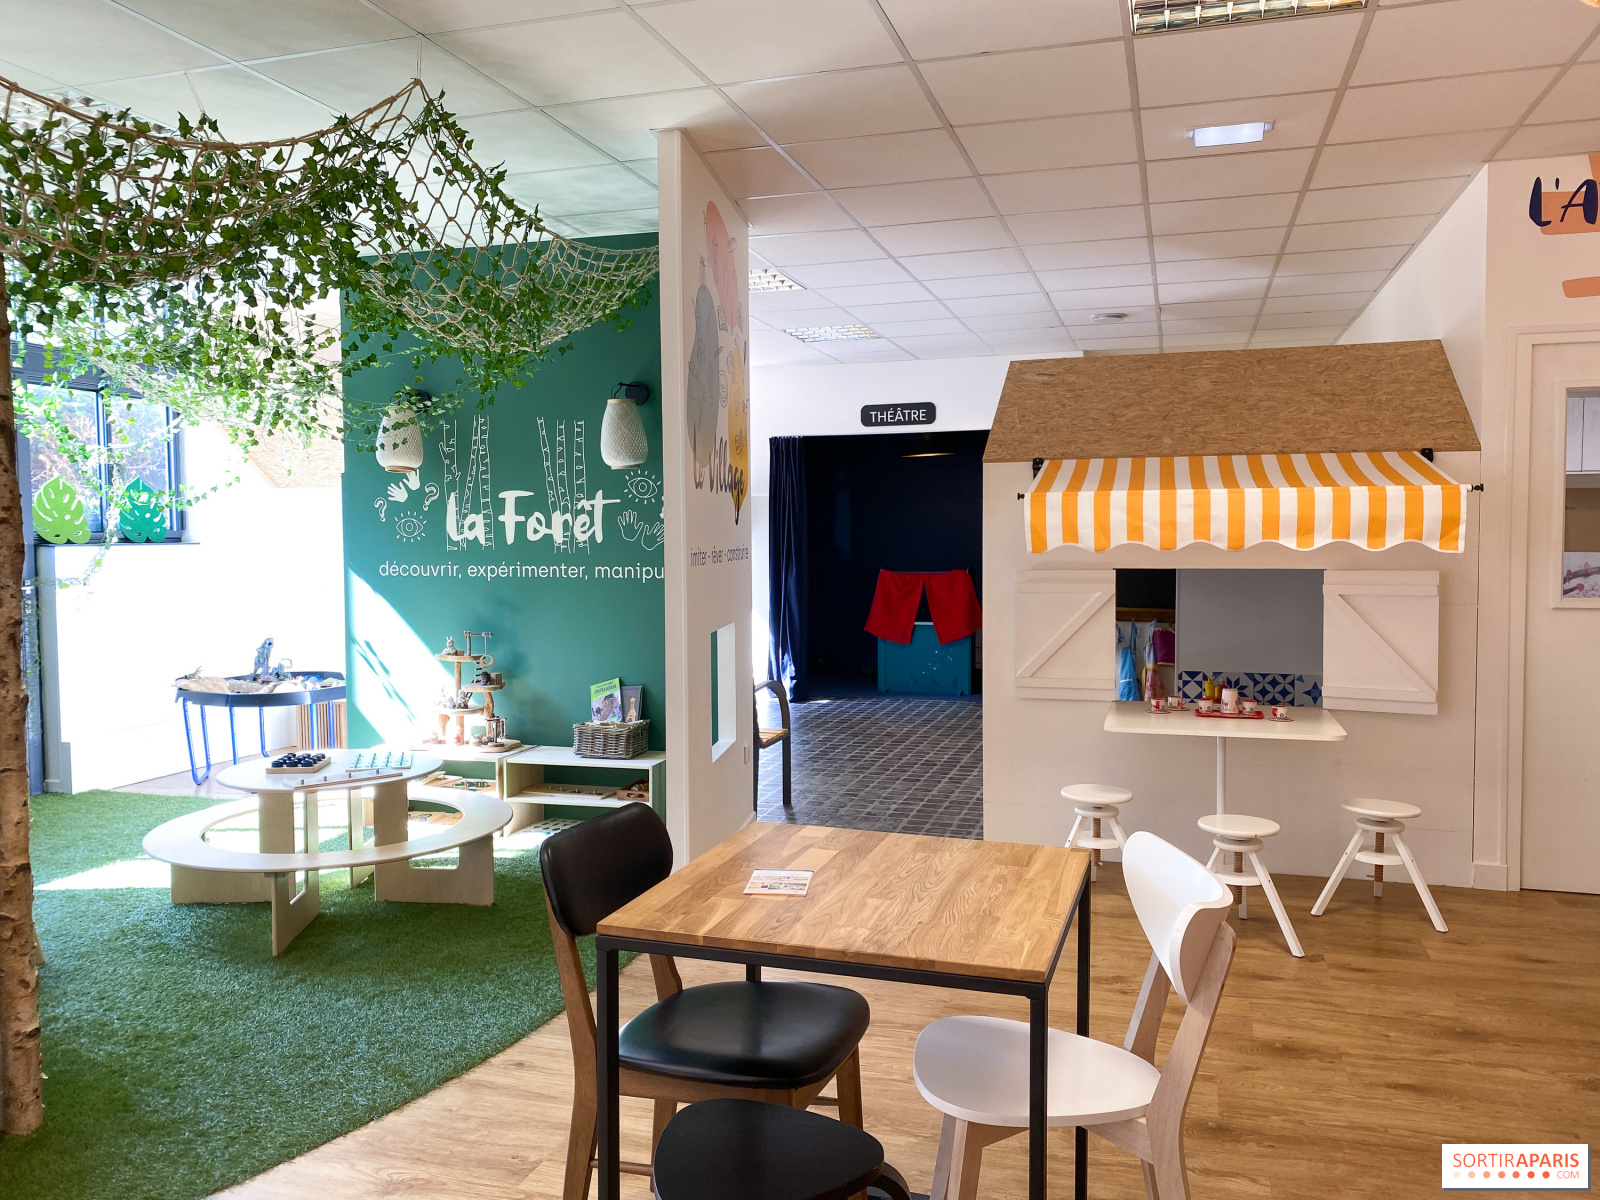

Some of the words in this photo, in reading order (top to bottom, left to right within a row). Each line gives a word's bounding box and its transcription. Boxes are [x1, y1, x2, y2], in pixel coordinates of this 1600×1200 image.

[1529, 176, 1600, 227] L'A
[869, 407, 927, 423] THÉÂTRE
[498, 489, 621, 546] Forêt
[690, 547, 708, 567] imiter
[711, 545, 724, 564] rêver
[727, 544, 749, 562] construire
[379, 560, 462, 579] découvrir,
[467, 561, 588, 581] expérimenter,
[594, 562, 664, 583] manipu
